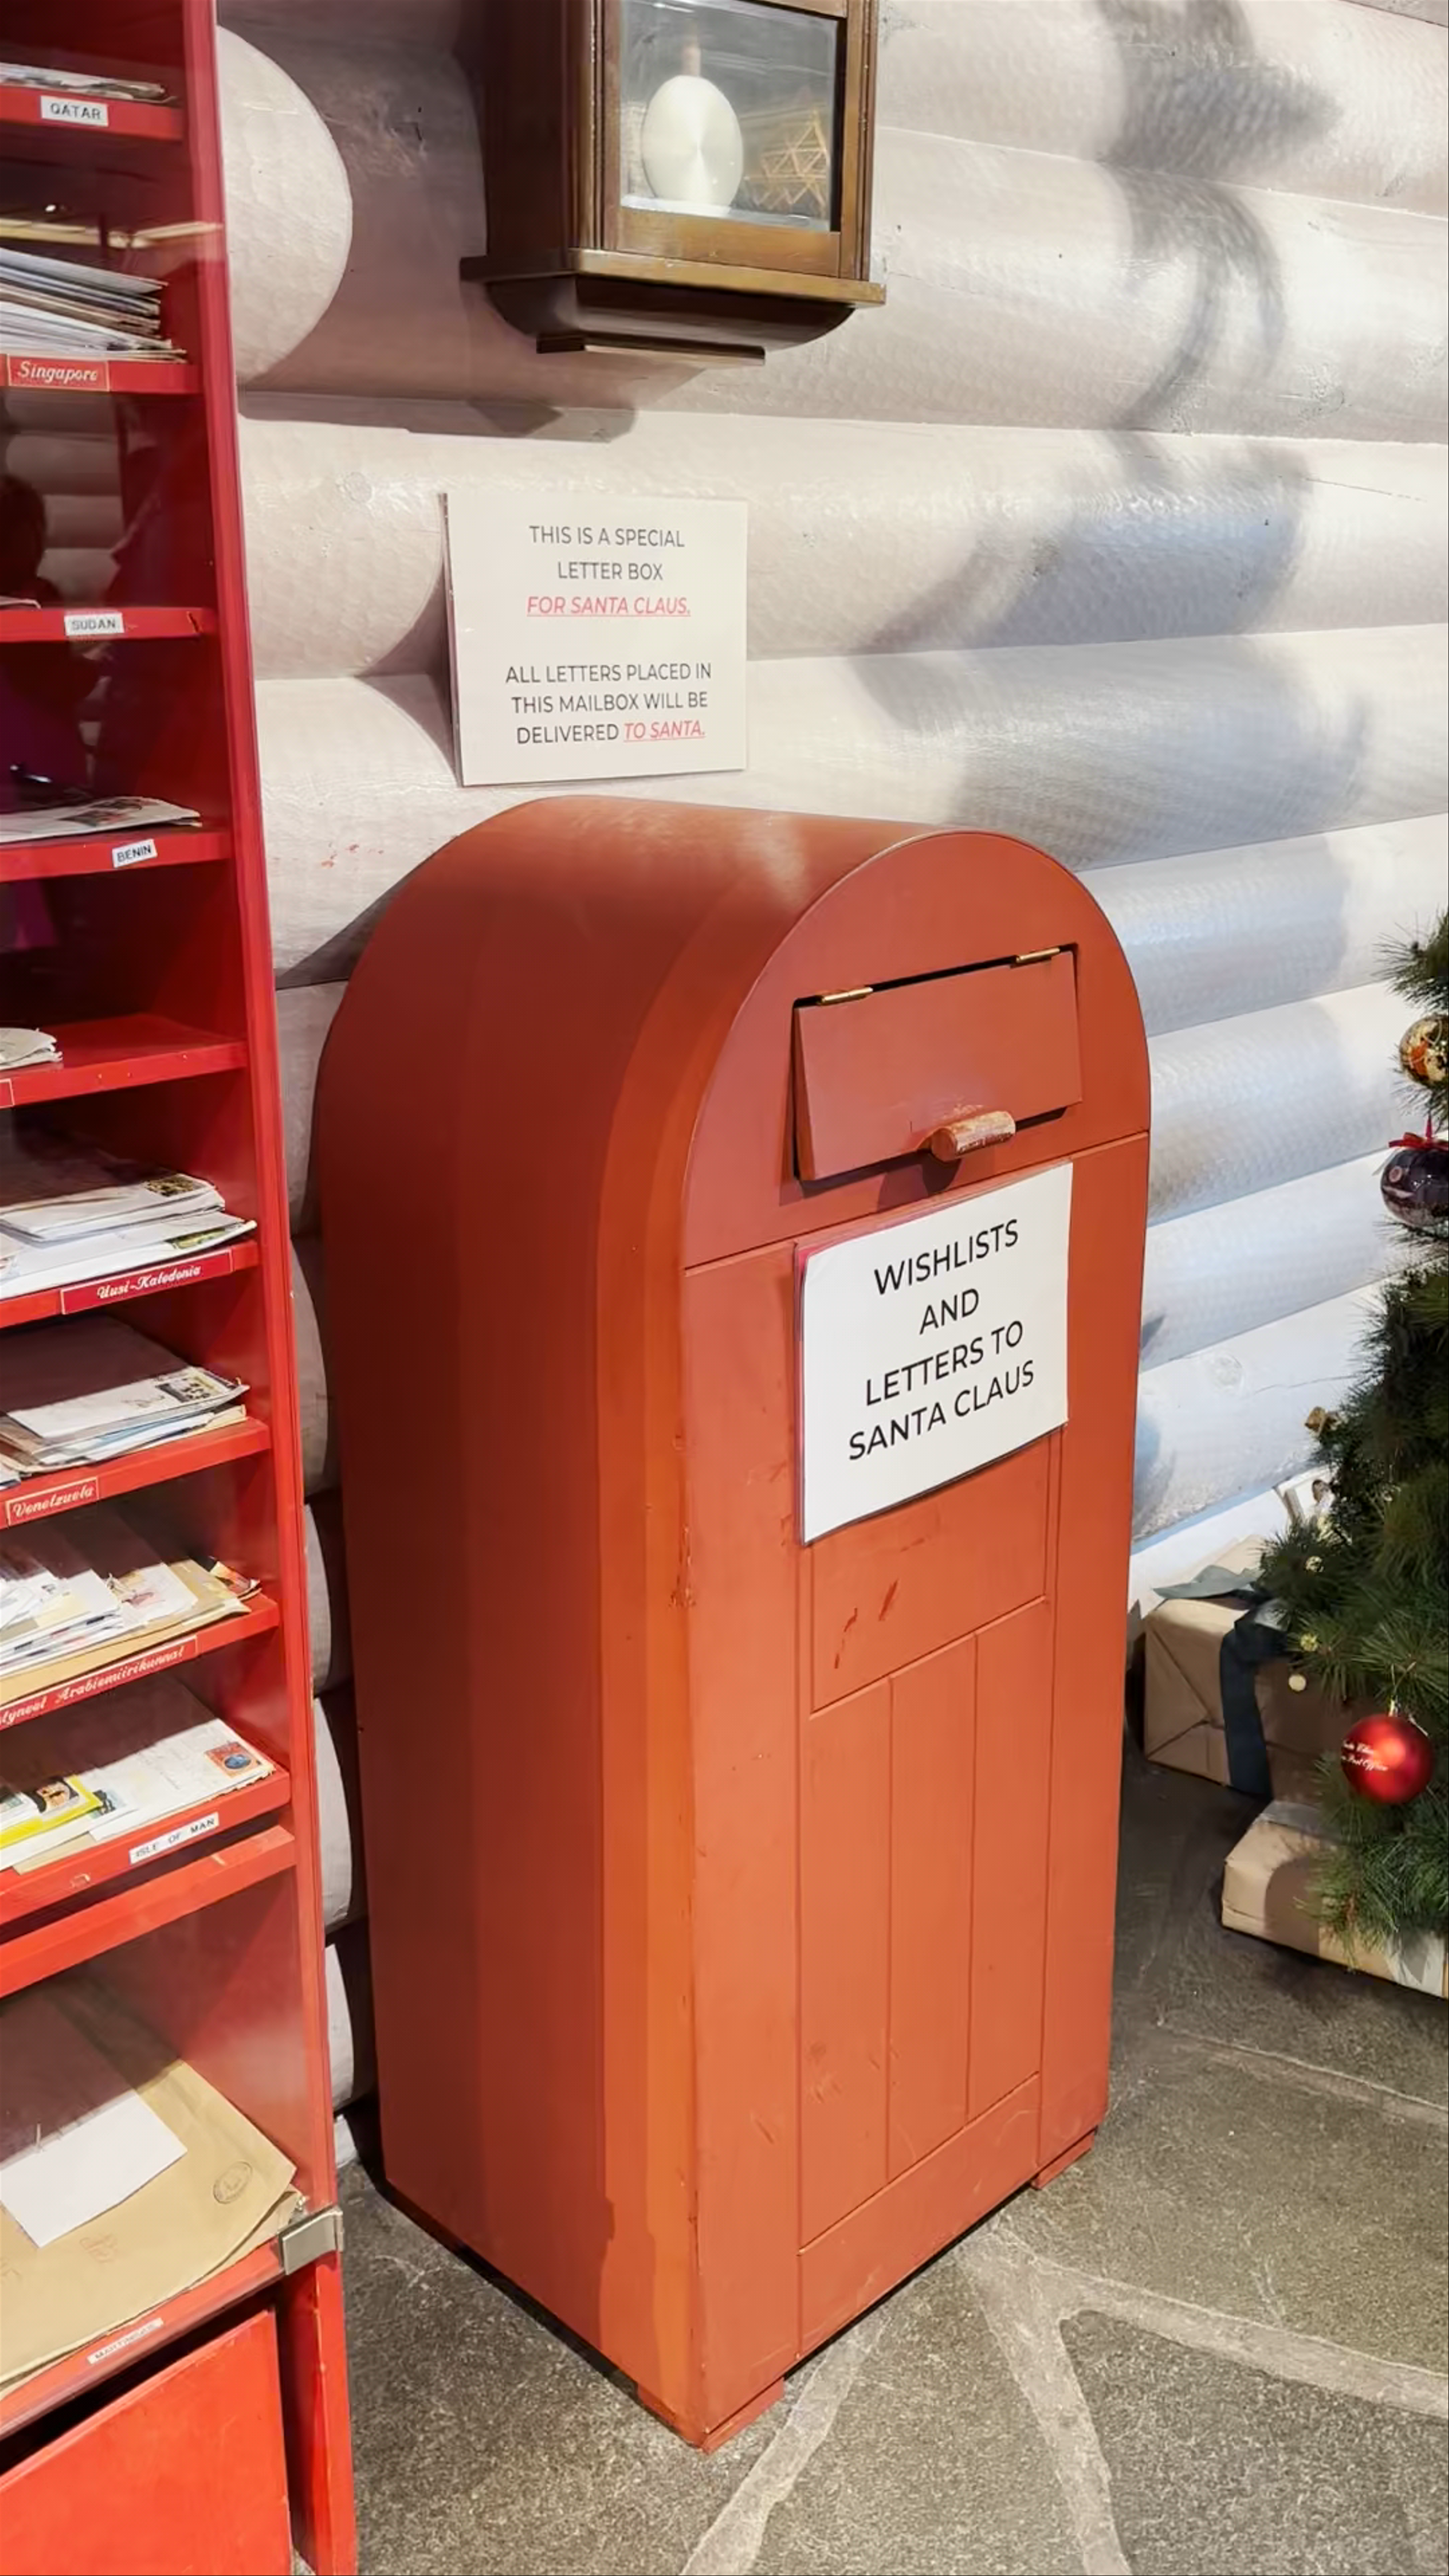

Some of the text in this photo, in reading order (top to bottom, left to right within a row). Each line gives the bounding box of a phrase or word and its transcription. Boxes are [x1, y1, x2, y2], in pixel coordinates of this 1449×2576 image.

[50, 102, 101, 120] QATAR
[18, 360, 97, 384] Singapore
[529, 526, 685, 547] THIS IS A SPECIAL
[558, 561, 663, 580] LETTER BOX
[528, 597, 691, 615] FOR SANTA CLAUS.
[72, 618, 115, 631] SUDAN
[506, 663, 711, 683] ALL LETTERS PLACED IN
[512, 692, 708, 713] THIS MAILBOX WILL BE
[517, 720, 705, 744] DELIVERED TO SANTA.
[117, 844, 151, 862] BENIN
[874, 1218, 1018, 1295] WISHLISTS
[919, 1287, 980, 1335] AND
[866, 1320, 1023, 1407] LETTERS TO
[848, 1360, 1035, 1461] SANTA CLAUS
[190, 1818, 215, 1833] MAN
